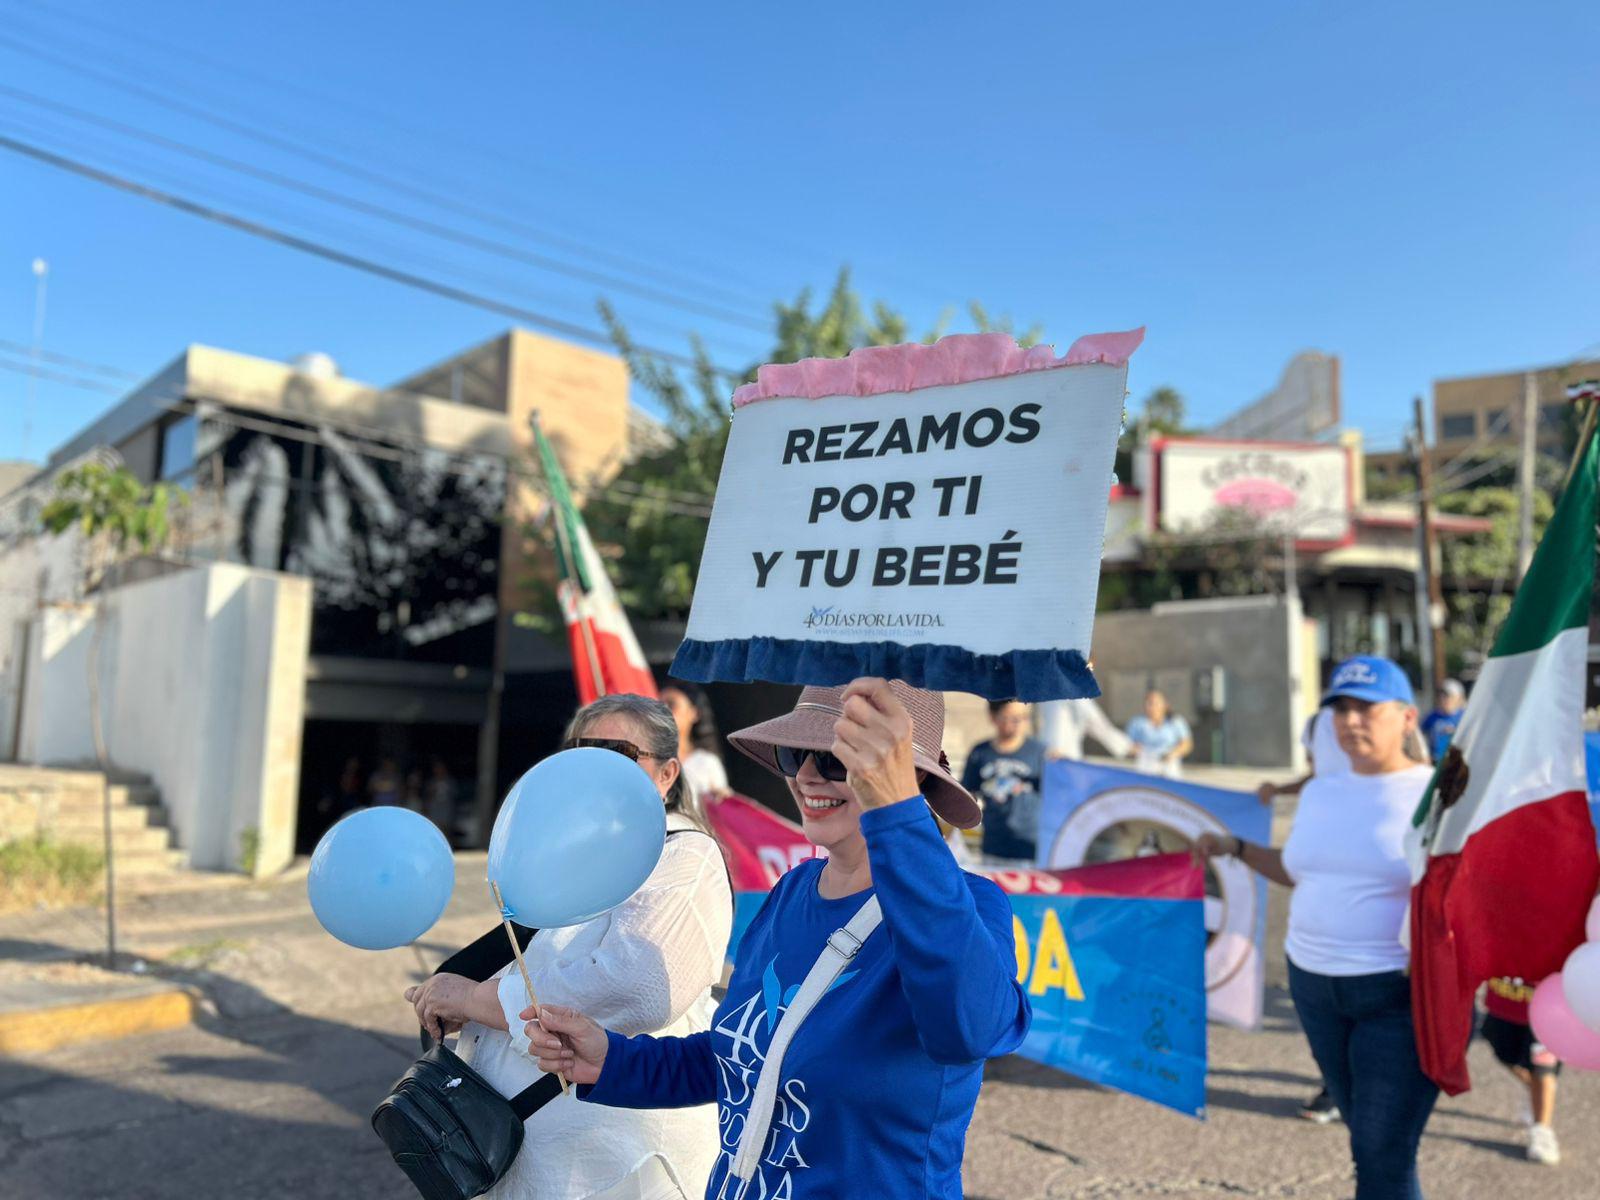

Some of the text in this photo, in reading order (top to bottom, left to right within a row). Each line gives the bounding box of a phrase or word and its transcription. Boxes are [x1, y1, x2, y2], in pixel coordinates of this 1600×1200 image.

[782, 402, 1043, 465] REZAMOS
[808, 474, 983, 524] POR TI
[751, 529, 1023, 588] Y TU BEBÉ
[763, 1127, 811, 1169] LA
